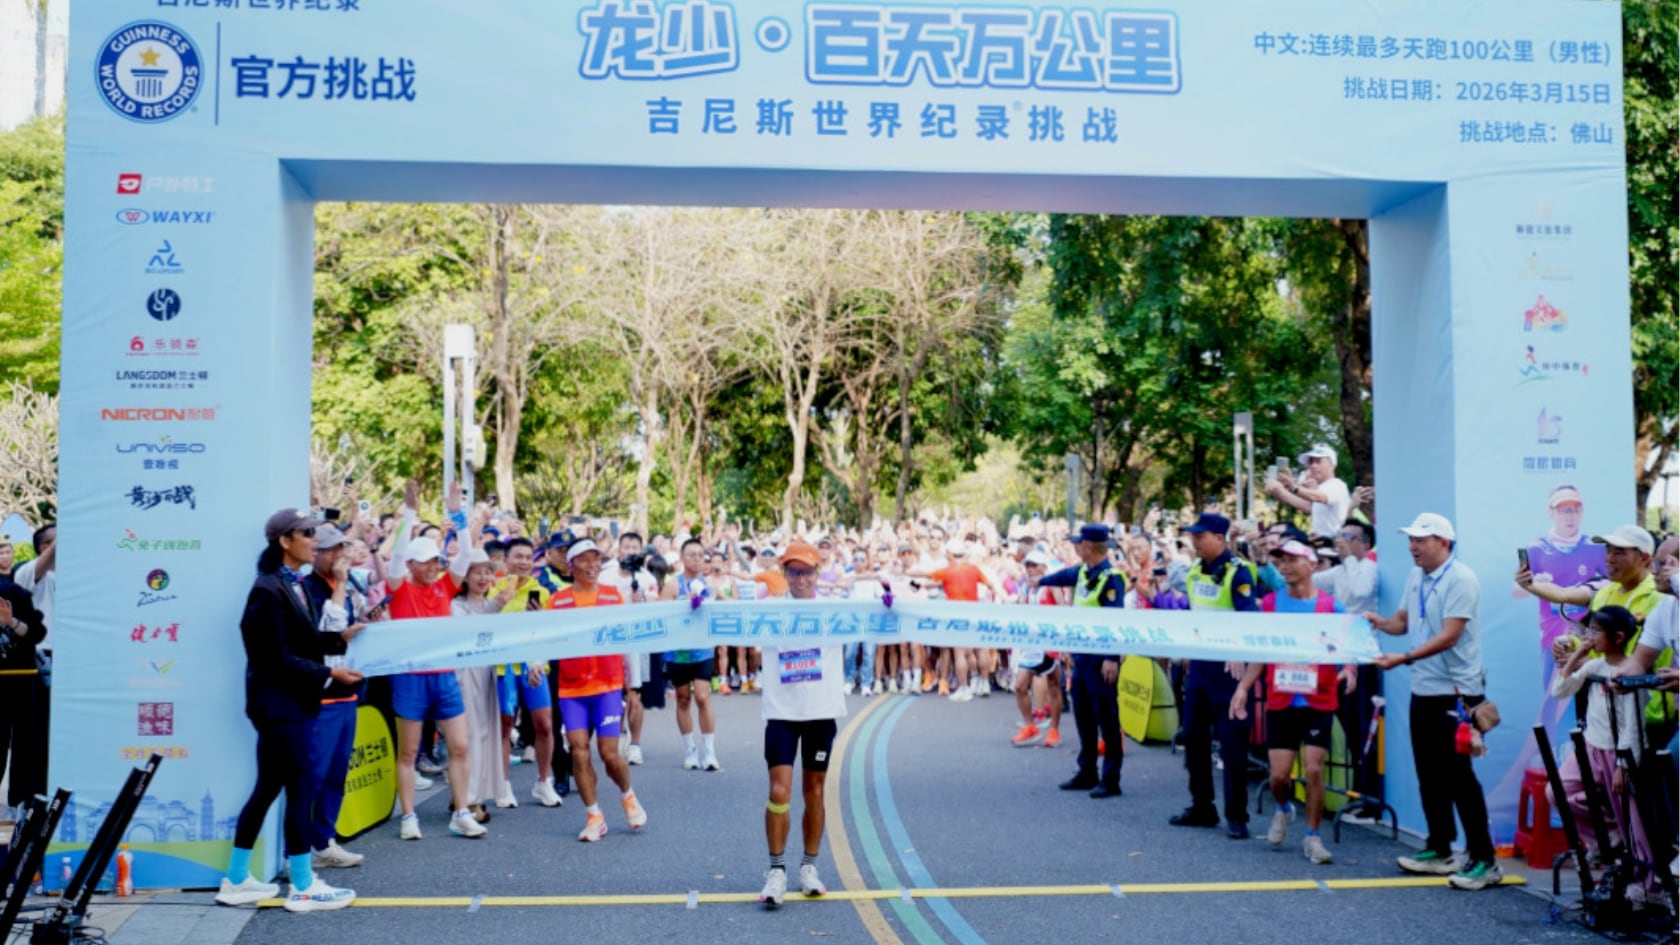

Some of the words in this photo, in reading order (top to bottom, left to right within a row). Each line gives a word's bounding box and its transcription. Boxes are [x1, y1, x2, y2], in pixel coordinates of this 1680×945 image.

[110, 26, 190, 55] GUINNESS
[101, 63, 136, 115] WORLD
[141, 64, 198, 119] RECORDS
[230, 55, 417, 102] 官方挑战
[1459, 120, 1614, 146] 挑战地点：佛山
[152, 210, 212, 224] WAYXI
[115, 370, 177, 381] LANGSDOM
[101, 408, 186, 421] NICRON
